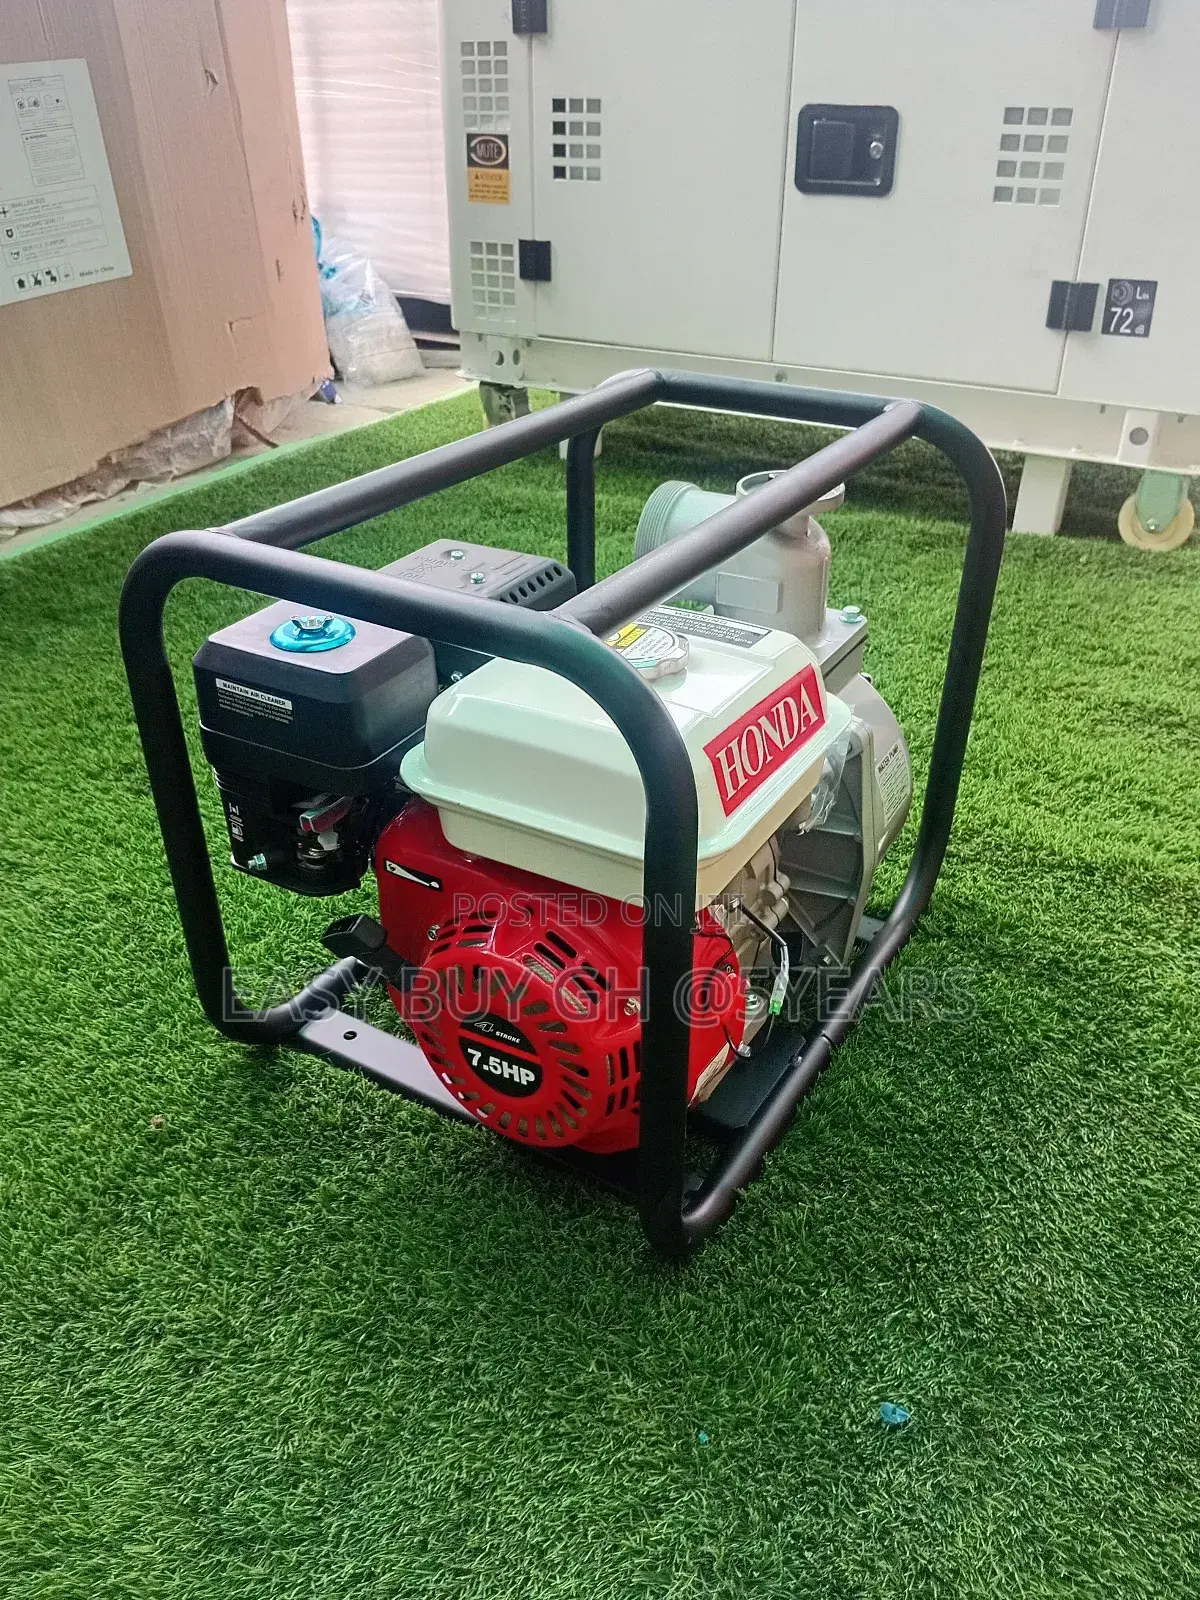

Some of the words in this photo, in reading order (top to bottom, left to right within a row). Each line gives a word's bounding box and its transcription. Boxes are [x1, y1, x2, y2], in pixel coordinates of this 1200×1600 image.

[476, 142, 500, 158] MUTE
[100, 265, 115, 273] China
[1109, 307, 1134, 334] 72
[674, 611, 728, 625] WARNING
[222, 682, 249, 695] MAINTAIN
[250, 690, 260, 700] AIR
[260, 694, 286, 706] CLEANER
[716, 684, 819, 801] HONDA
[495, 1031, 521, 1044] STROKE
[467, 1047, 536, 1086] 7.5HP
